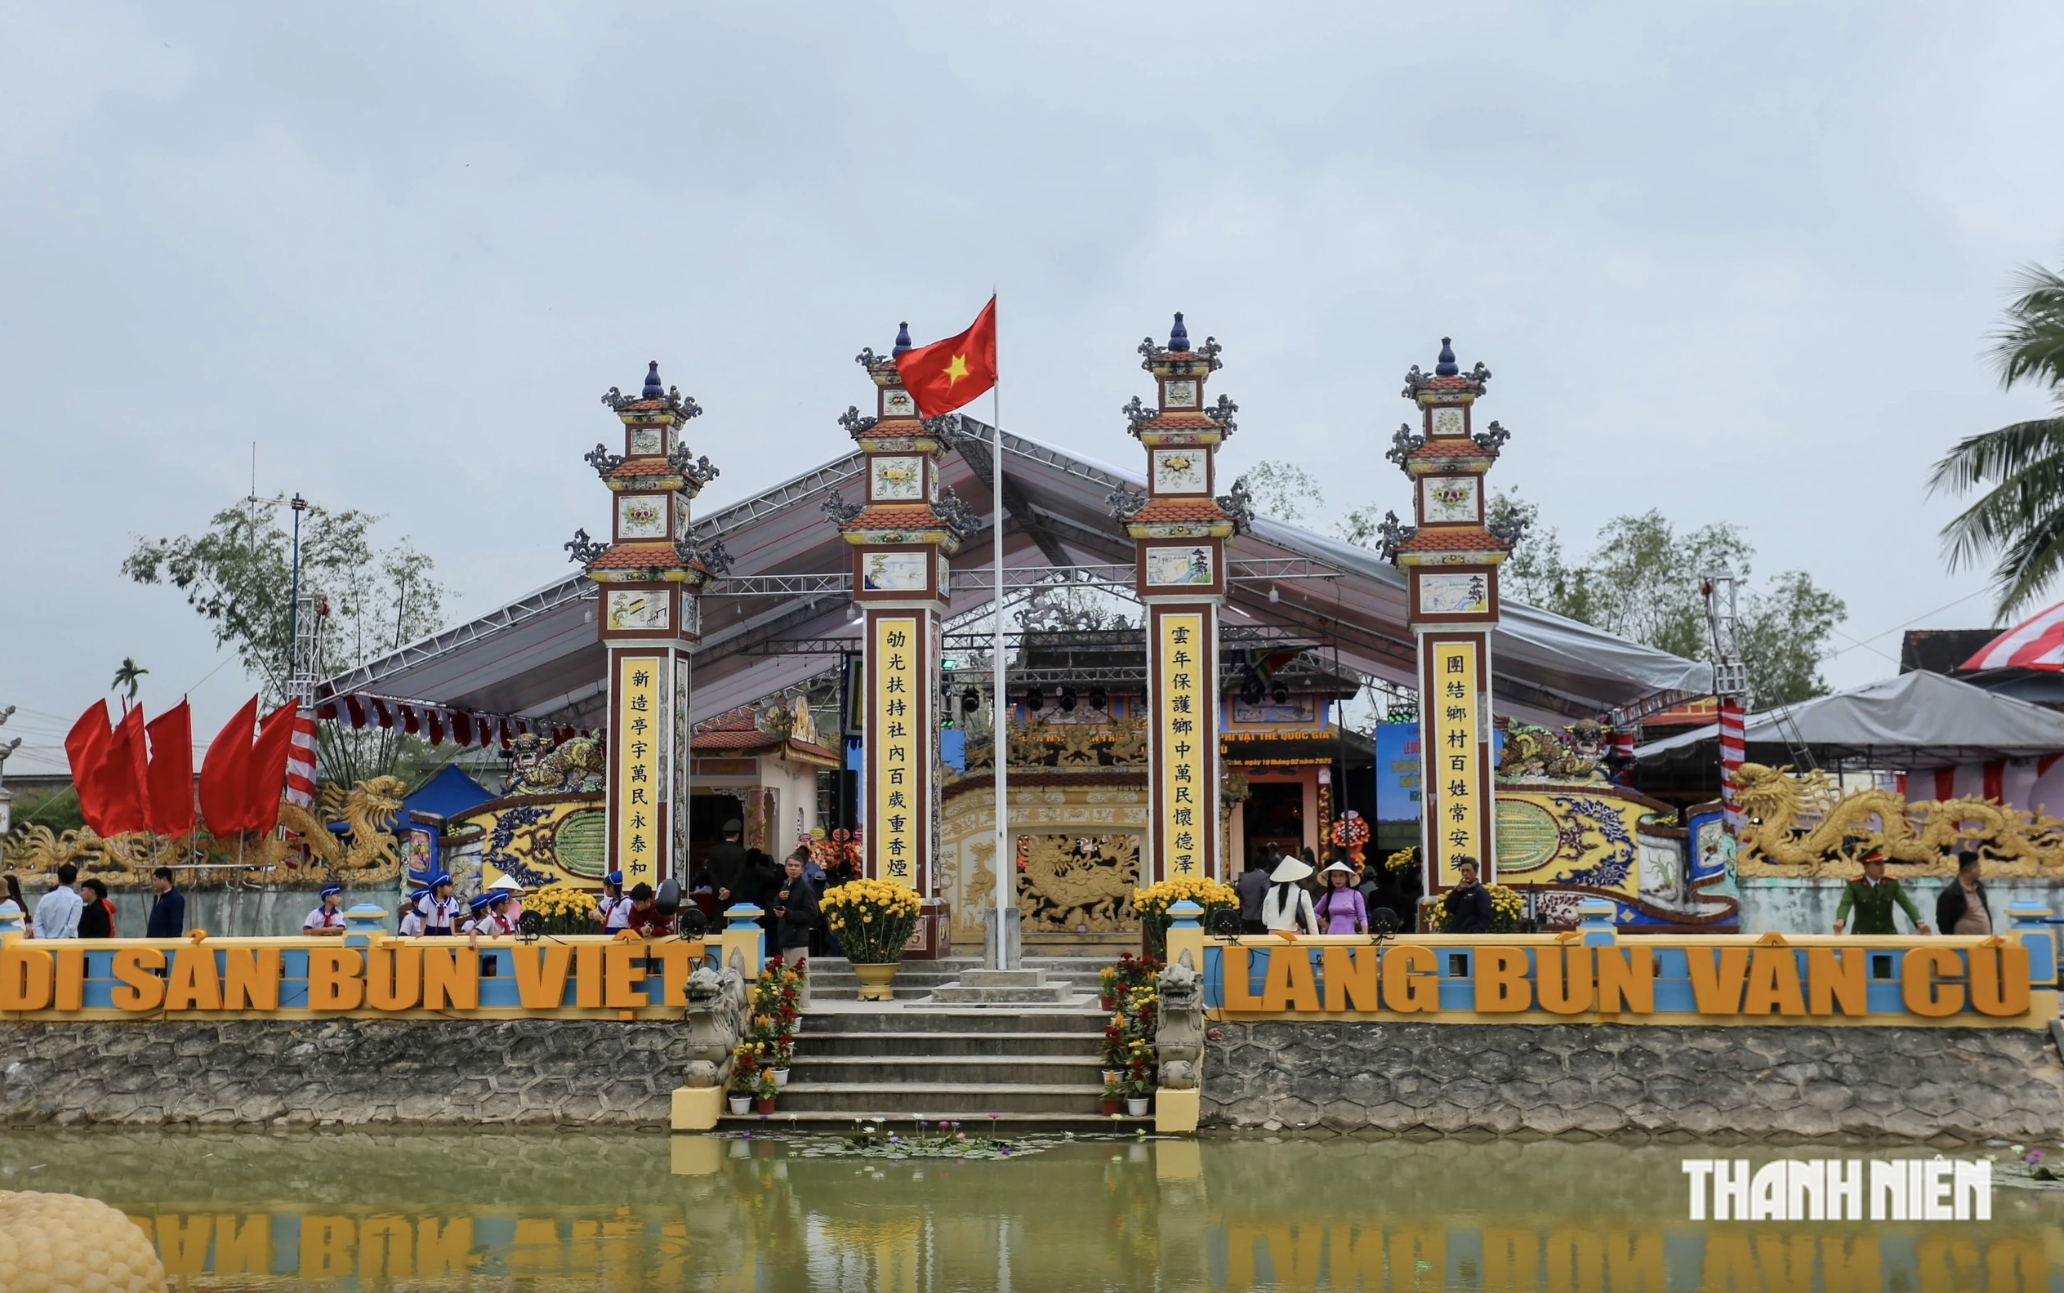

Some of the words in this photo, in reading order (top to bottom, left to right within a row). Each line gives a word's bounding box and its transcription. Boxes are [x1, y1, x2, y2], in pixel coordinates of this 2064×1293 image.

[629, 669, 650, 877] 新造亭宇萬民永泰和
[0, 948, 84, 1011] DI
[111, 928, 280, 1011] SẢN
[511, 929, 705, 1021] VIỆT
[1222, 930, 1439, 1013] LÀNG
[1474, 931, 1654, 1014] BÚN
[1685, 931, 1868, 1016] VÂN
